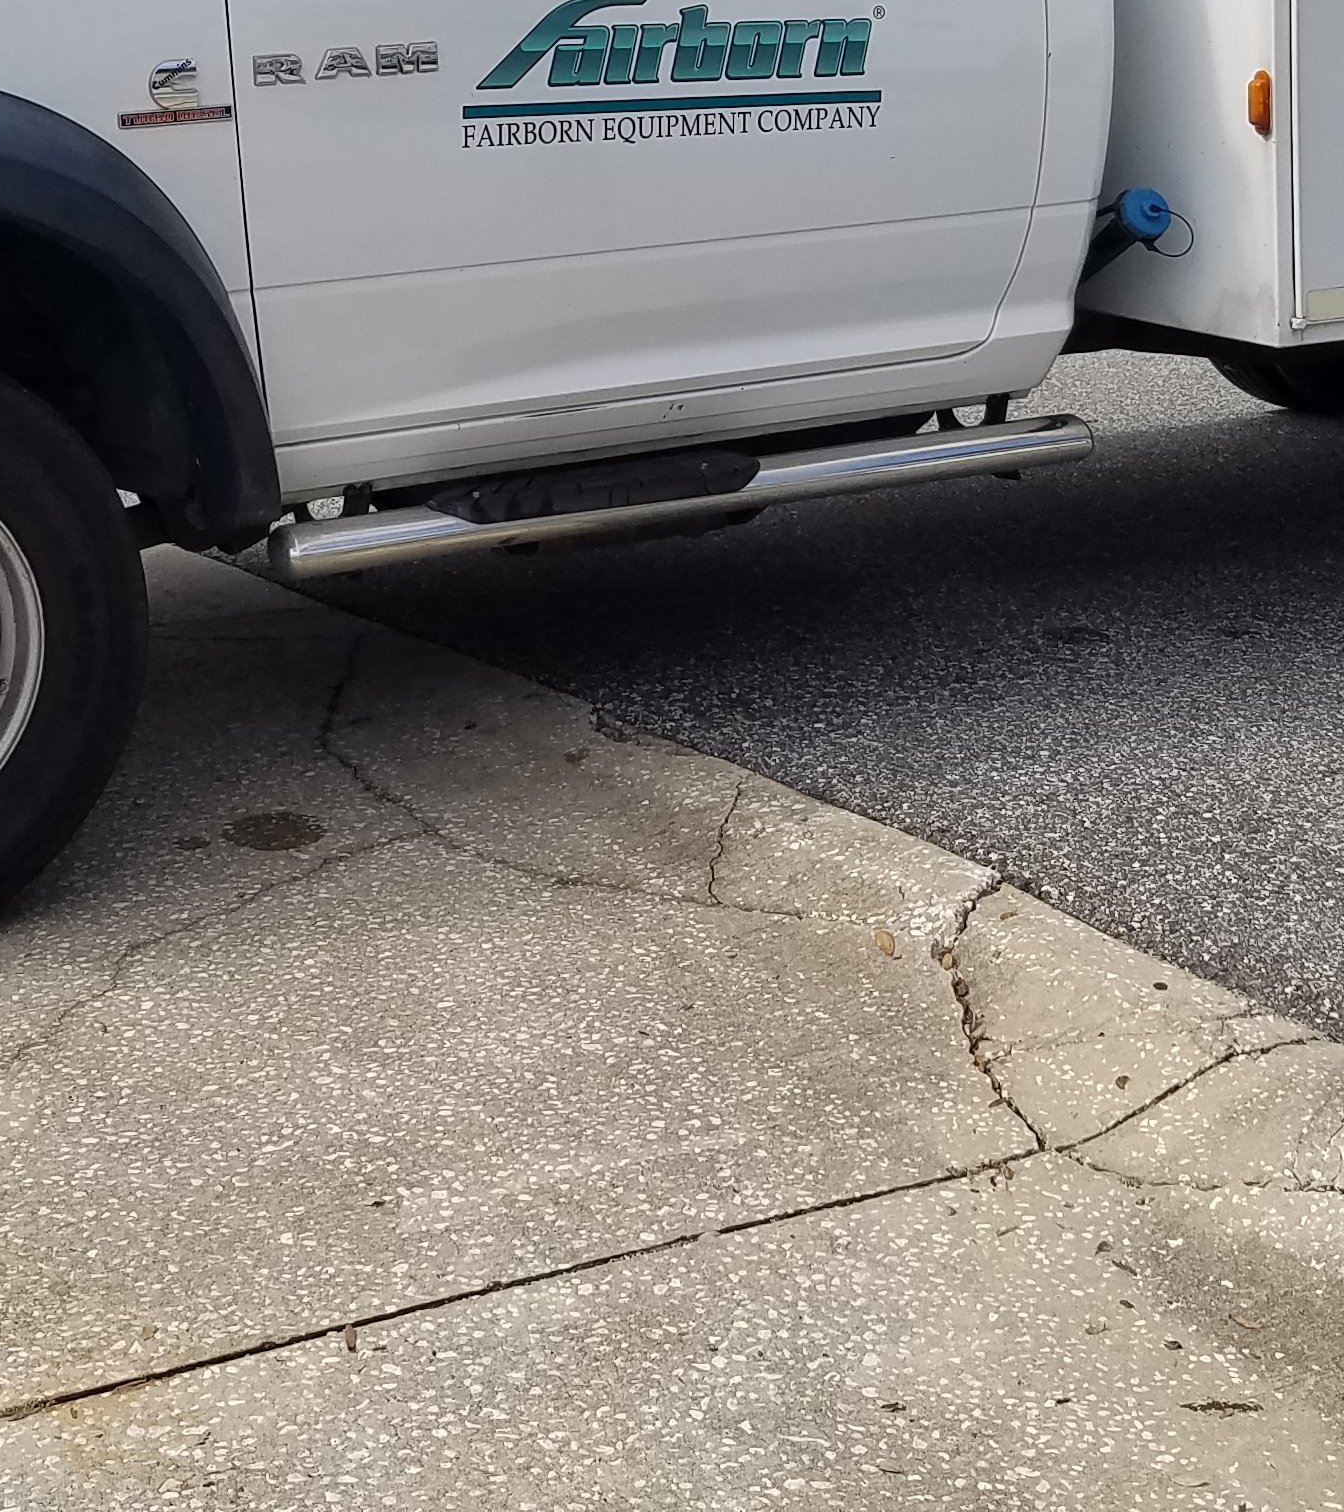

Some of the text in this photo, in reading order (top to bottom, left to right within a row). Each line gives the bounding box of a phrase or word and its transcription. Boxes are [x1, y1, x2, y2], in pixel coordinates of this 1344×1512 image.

[152, 58, 192, 90] Cummins
[252, 41, 440, 87] RAM
[461, 105, 881, 149] FAIRBORN EQUIPMENT COMPANY
